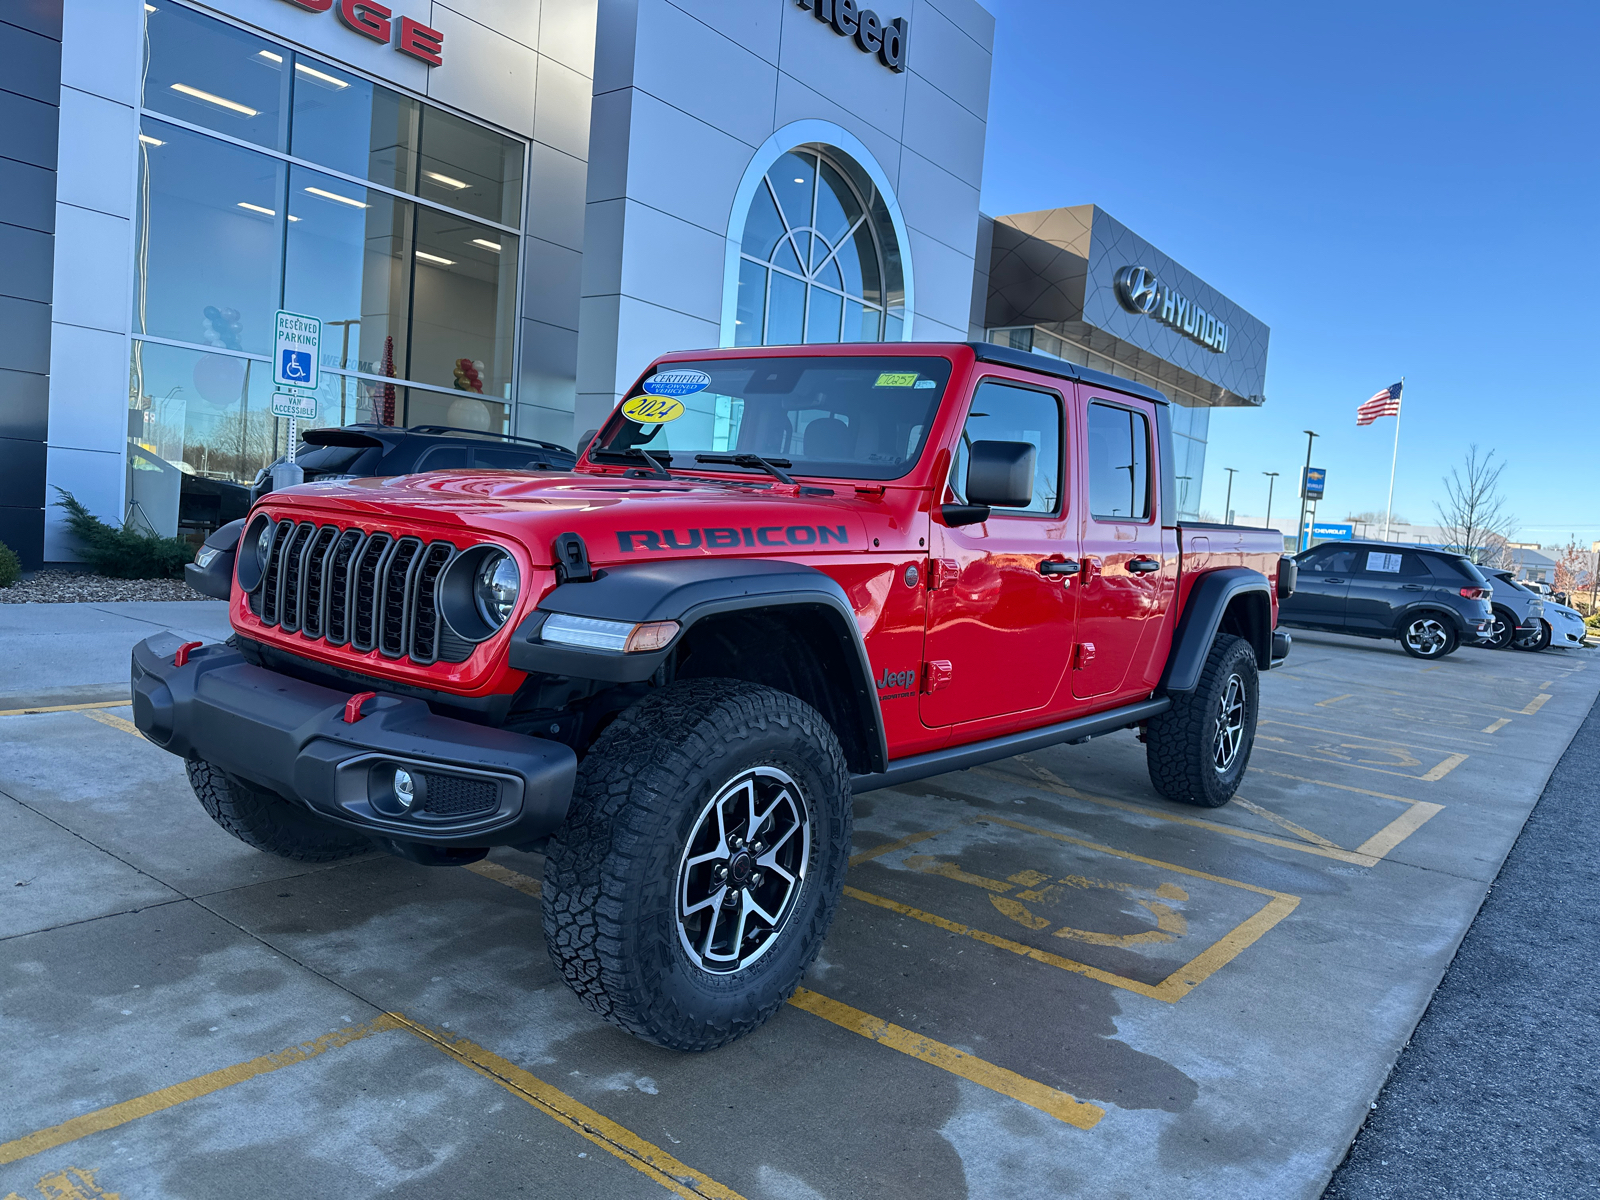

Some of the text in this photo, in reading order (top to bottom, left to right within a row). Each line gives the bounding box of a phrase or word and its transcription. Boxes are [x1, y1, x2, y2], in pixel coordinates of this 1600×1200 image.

[284, 0, 444, 67] GE
[279, 318, 317, 333] RESERVED
[1160, 285, 1229, 354] HYUNDAI
[278, 331, 317, 346] PARKING
[653, 374, 706, 383] CERTIFIED
[288, 397, 302, 405] VAN
[626, 398, 679, 419] 2024
[274, 404, 315, 416] ACCESSIBLE
[615, 525, 850, 553] RUBICON
[1314, 528, 1347, 536] CHEVROLET
[876, 668, 916, 690] Jeep
[878, 691, 910, 701] LADIATOR
